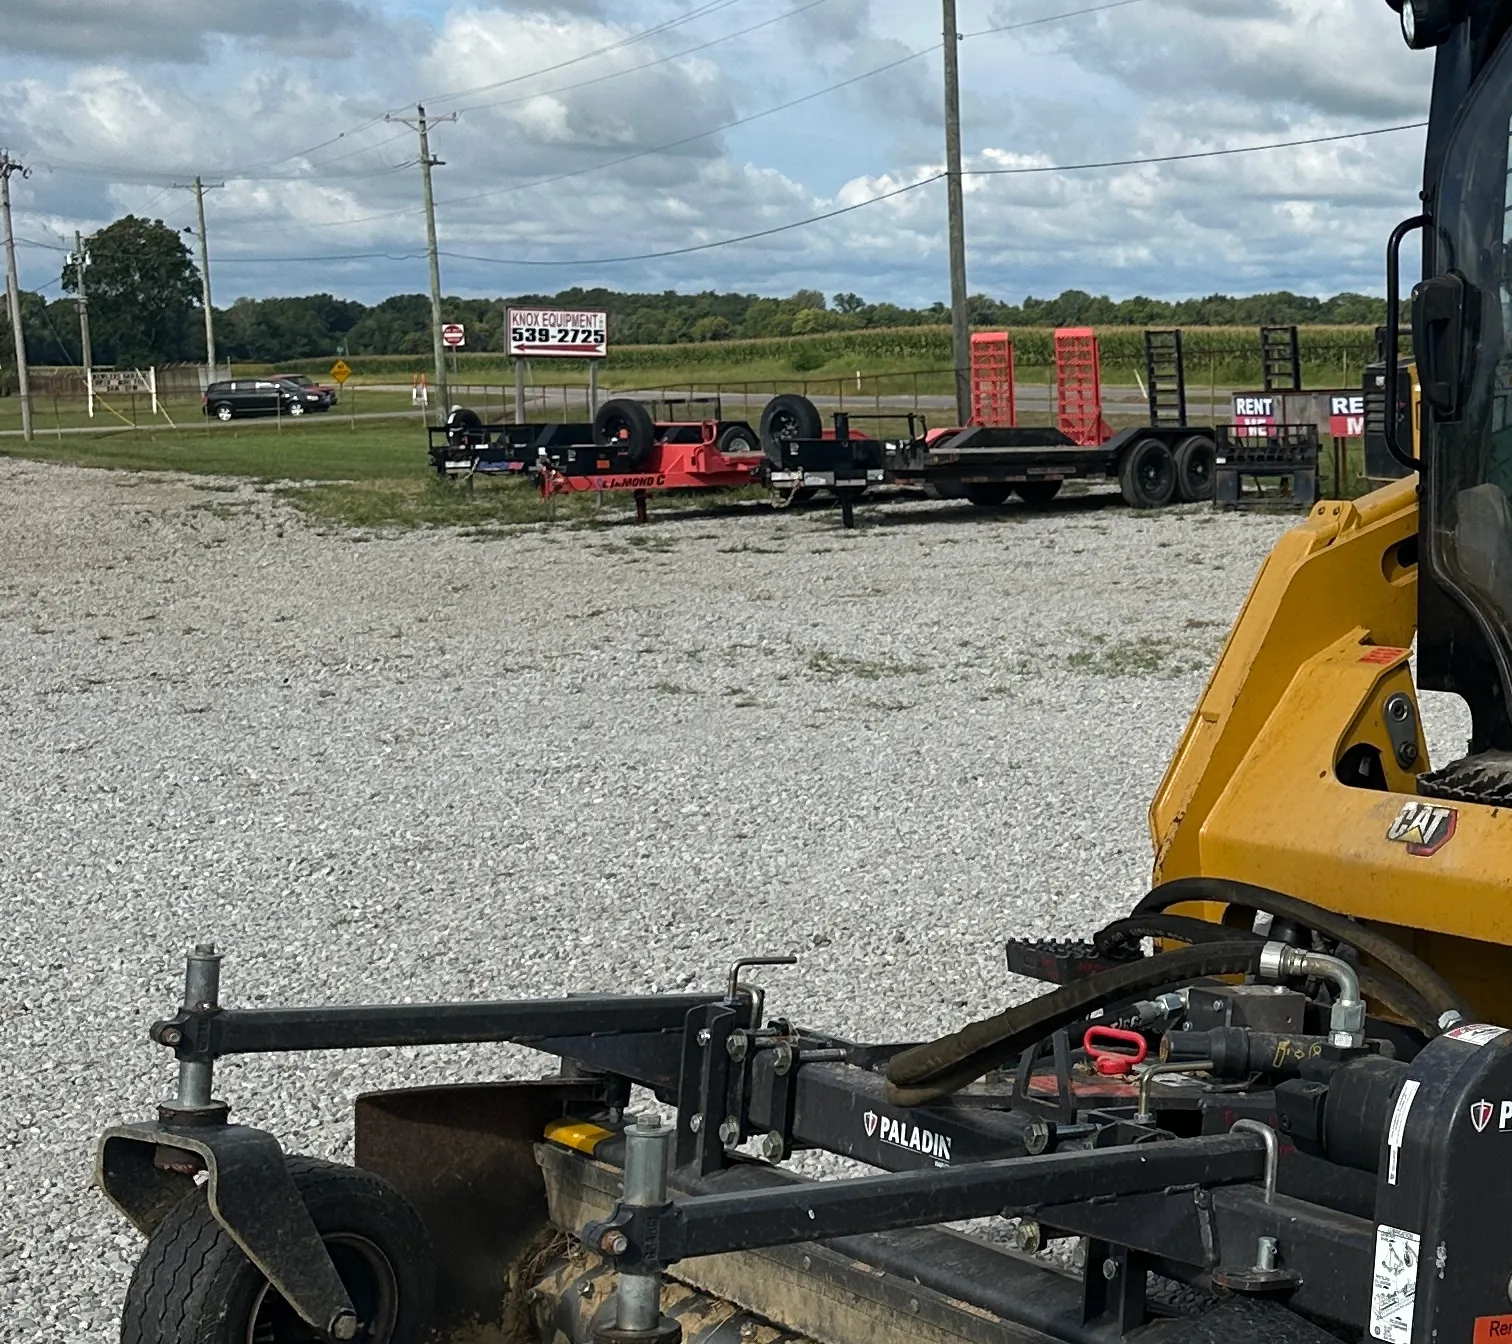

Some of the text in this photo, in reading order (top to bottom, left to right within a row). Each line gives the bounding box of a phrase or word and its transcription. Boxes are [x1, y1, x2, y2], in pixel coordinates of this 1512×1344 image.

[512, 312, 540, 327] KNOX
[542, 312, 598, 329] EQUIPMENT
[512, 327, 605, 343] 539-2725
[1236, 397, 1272, 415] RENT
[1388, 801, 1451, 844] CAT
[880, 1115, 952, 1160] PALADIN
